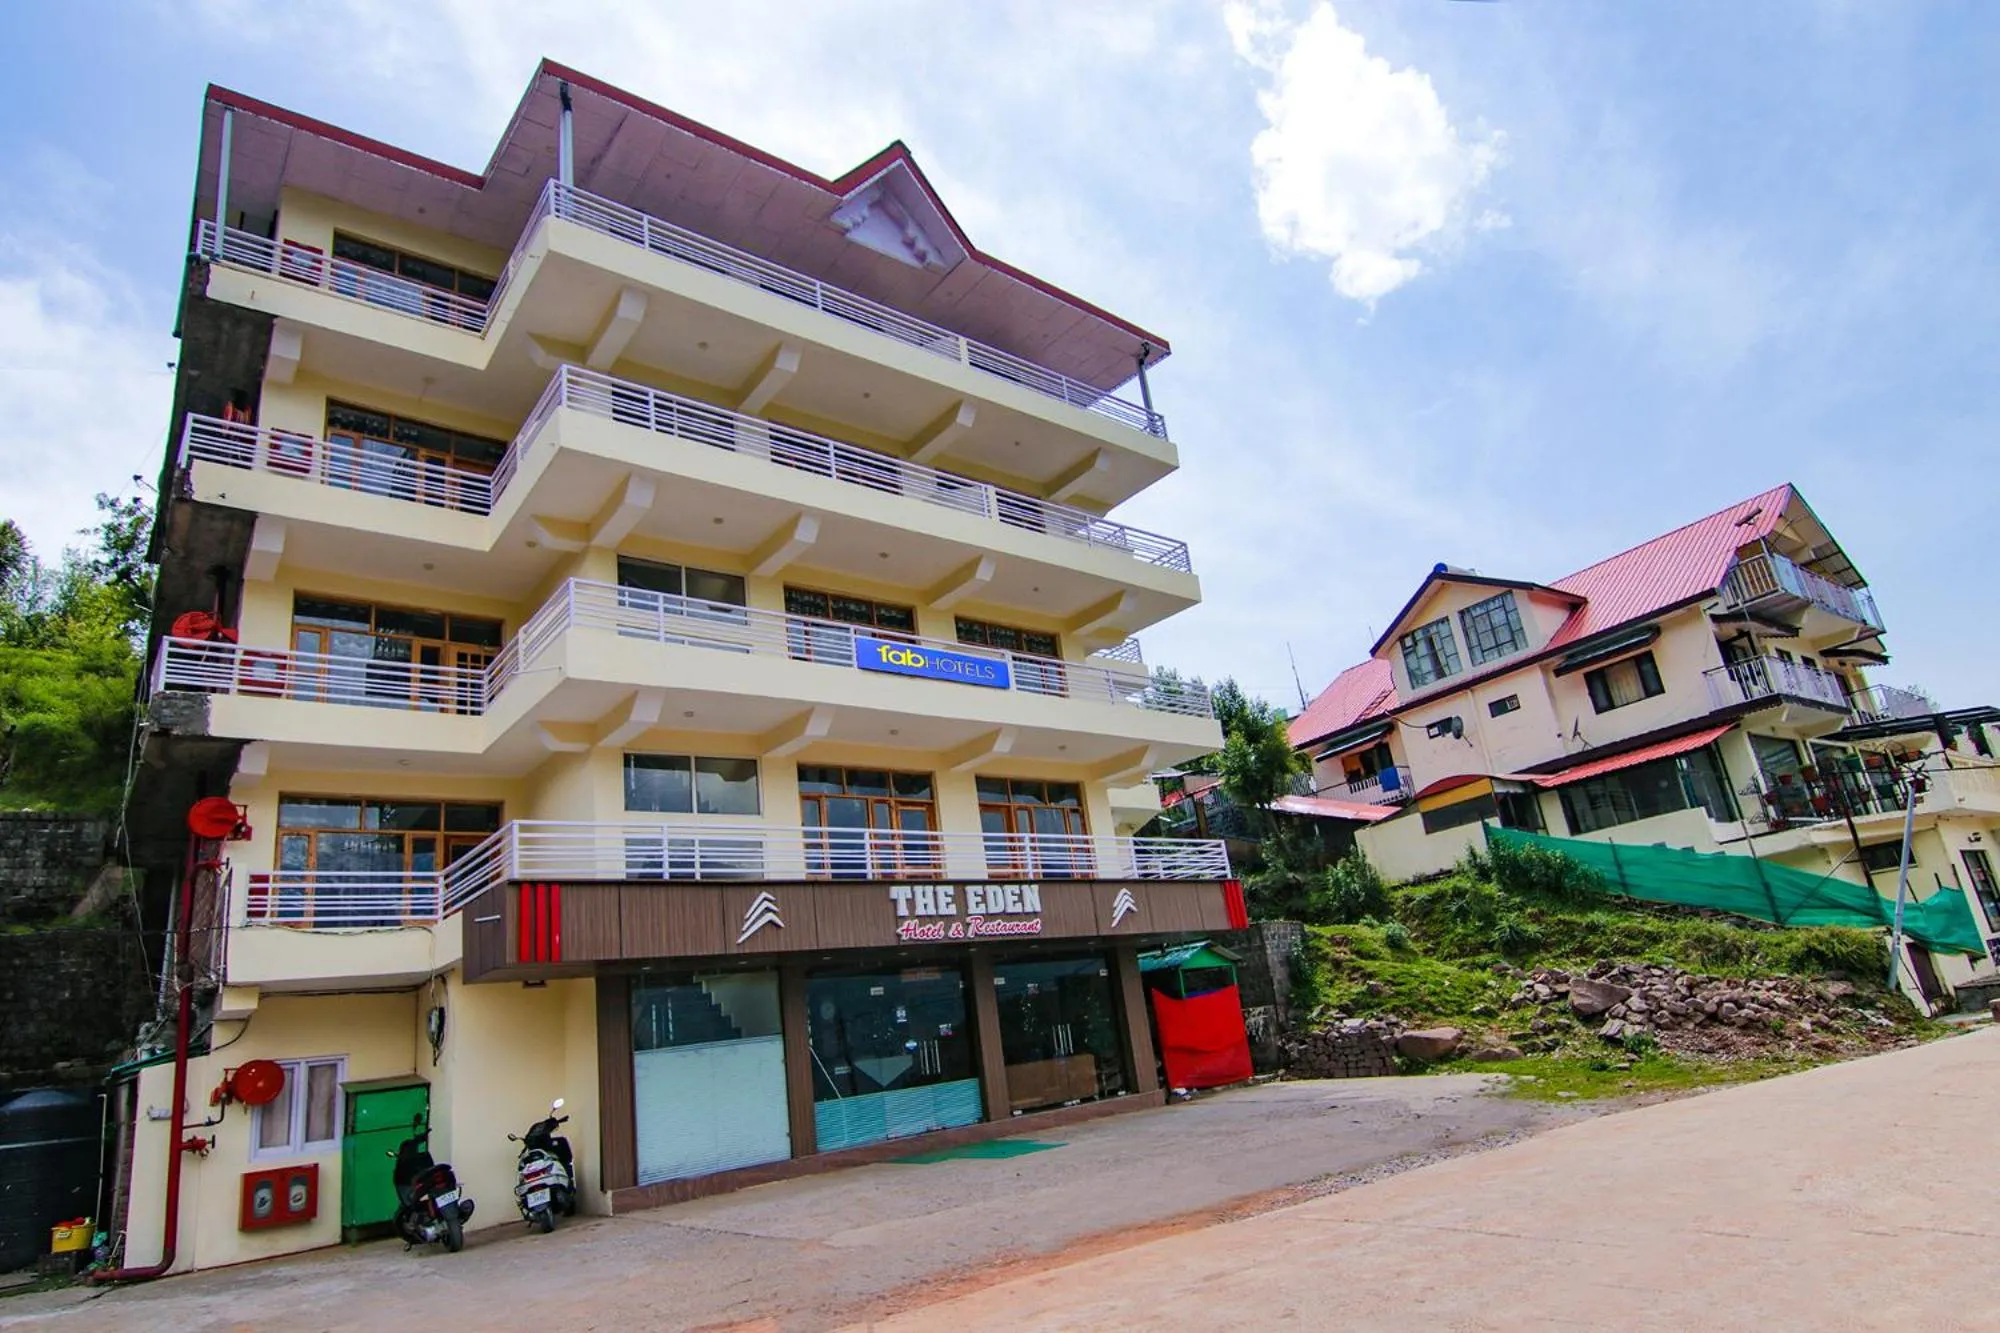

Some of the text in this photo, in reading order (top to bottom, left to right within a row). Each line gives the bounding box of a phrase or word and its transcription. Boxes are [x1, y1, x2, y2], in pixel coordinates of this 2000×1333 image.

[889, 884, 1042, 917] THE EDEN
[898, 916, 1042, 940] Hotel & Restaurant
